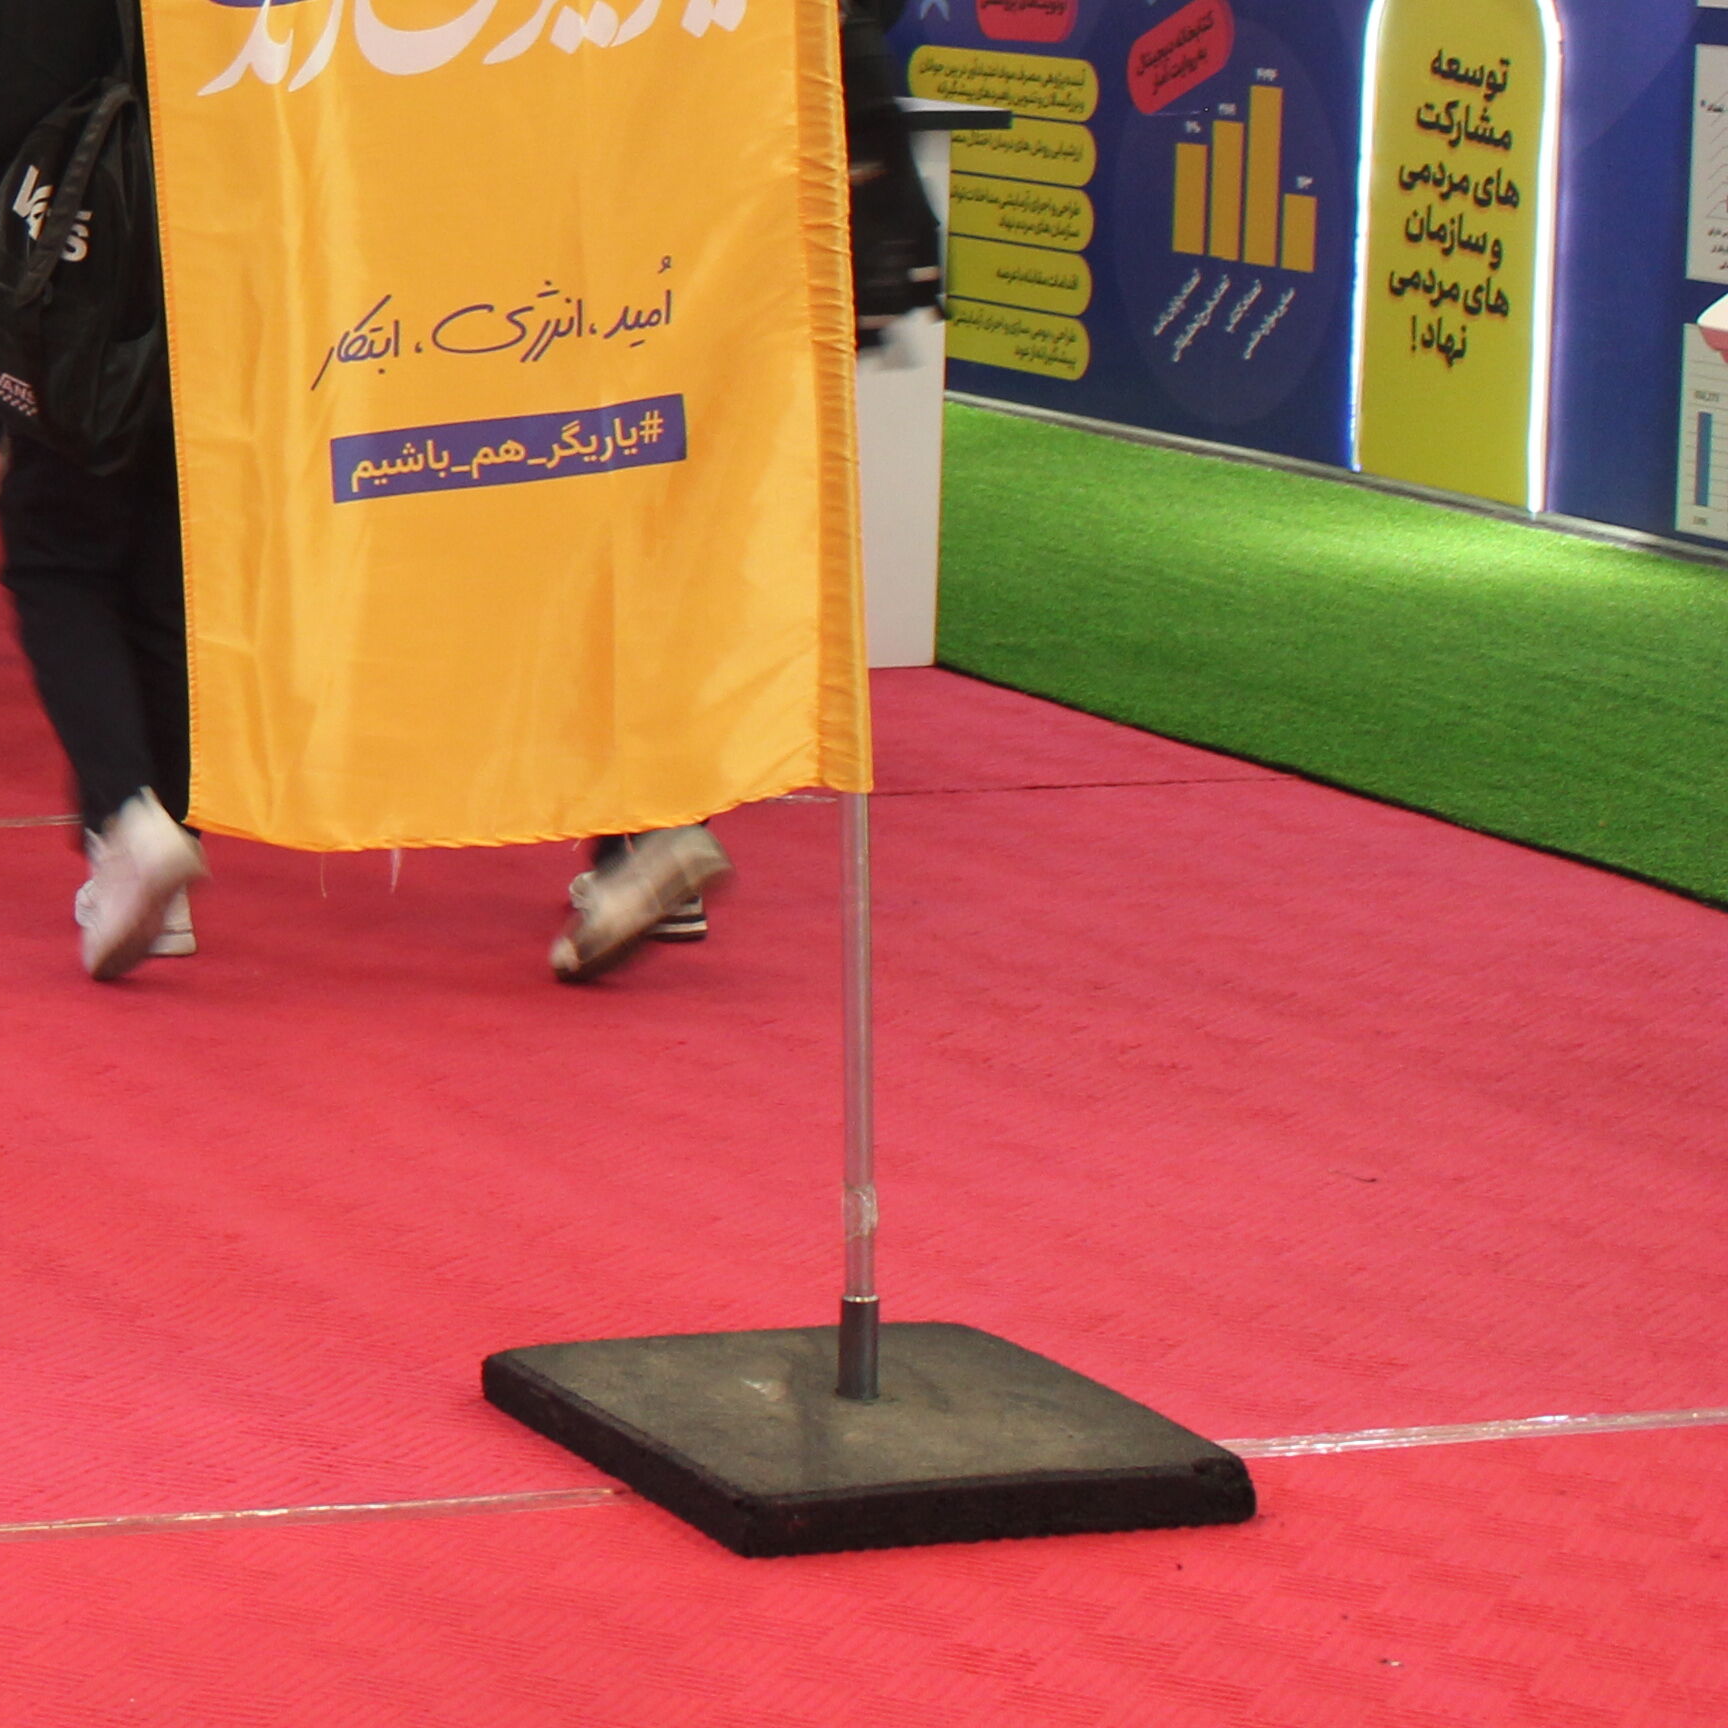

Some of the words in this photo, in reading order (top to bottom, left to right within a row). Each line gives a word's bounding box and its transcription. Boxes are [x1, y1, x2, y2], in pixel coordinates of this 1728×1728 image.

[1430, 48, 1511, 101] توسعه
[1416, 100, 1512, 152] مشارکت
[1398, 160, 1471, 200] مردمی
[1474, 167, 1520, 209] های
[1404, 204, 1487, 256] سازمان
[1489, 236, 1504, 271] و
[1388, 268, 1461, 309] مردمی
[1463, 276, 1510, 318] های
[310, 294, 400, 392] ابتکار
